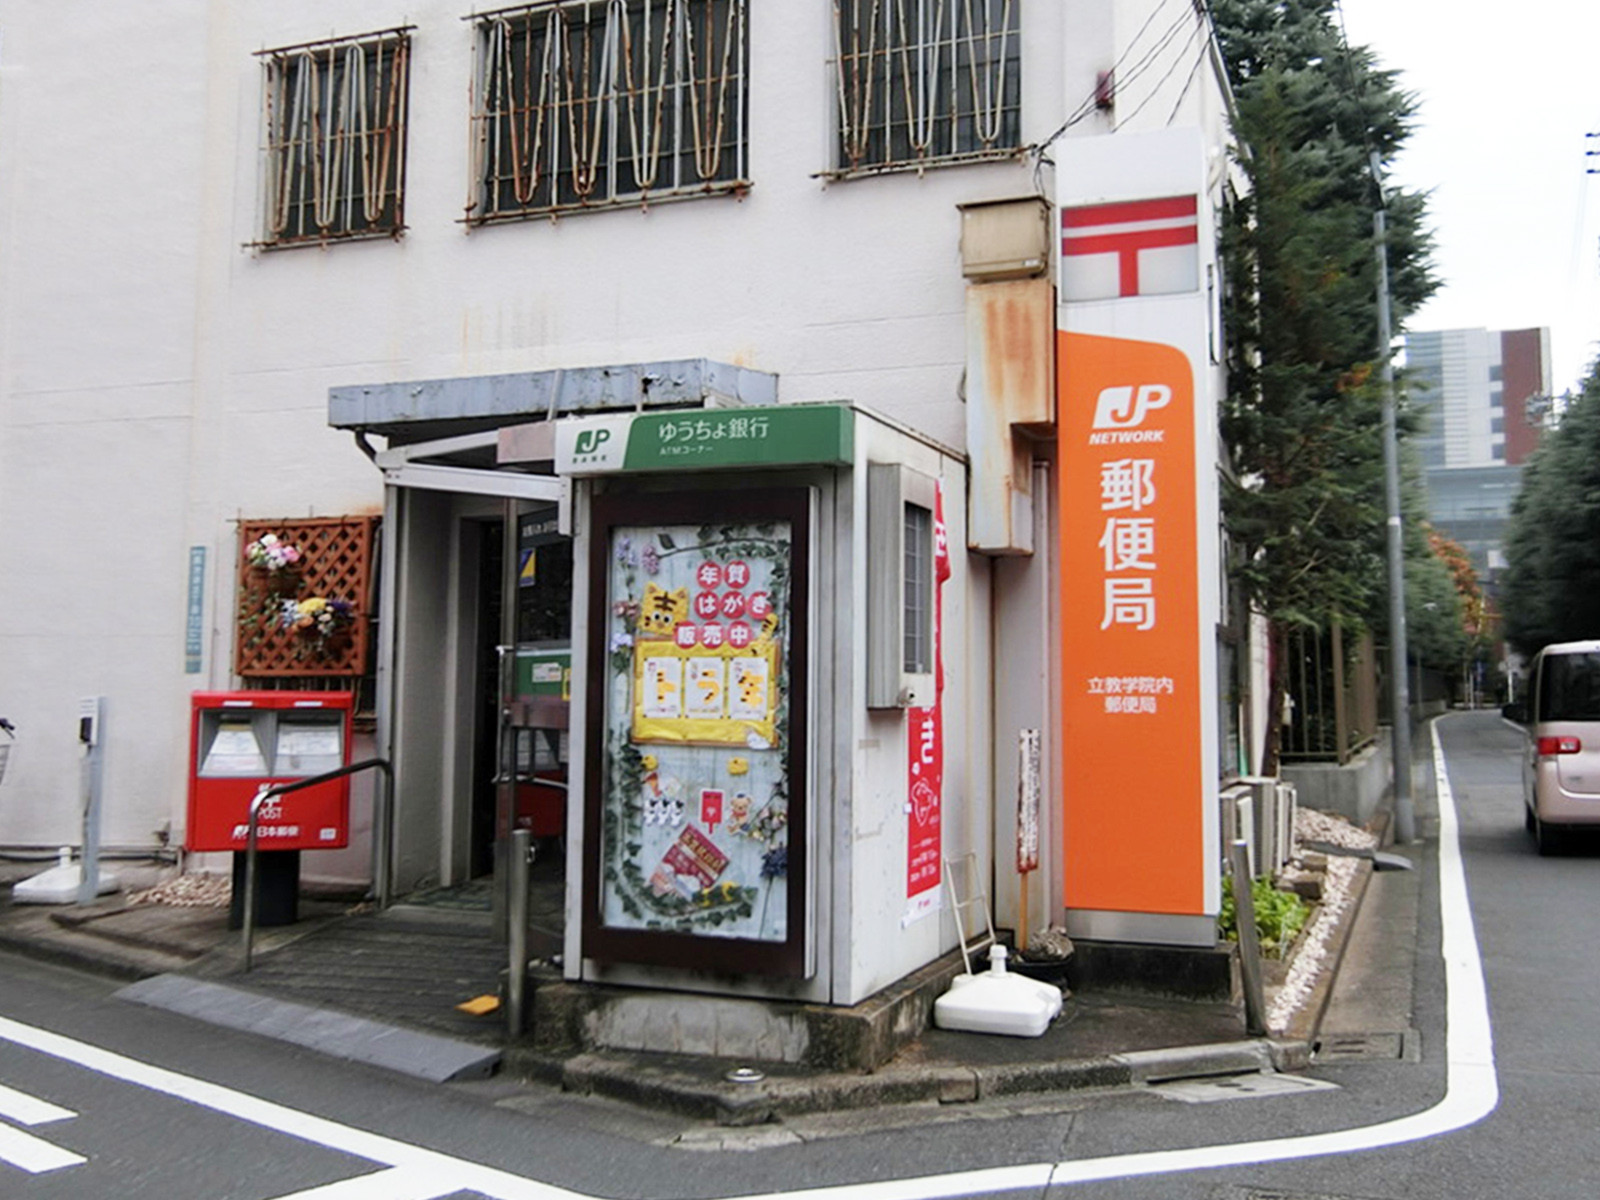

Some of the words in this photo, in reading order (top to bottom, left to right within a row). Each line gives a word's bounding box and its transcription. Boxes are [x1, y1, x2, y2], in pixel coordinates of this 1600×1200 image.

[1092, 384, 1172, 428] JP
[659, 416, 769, 442] ゆうちょ銀行
[1088, 429, 1165, 445] NETWORK
[575, 429, 611, 455] JP
[1098, 458, 1156, 631] 郵便局
[700, 564, 746, 586] 年賀
[699, 591, 770, 615] はがき
[676, 625, 749, 646] 販売中
[1087, 676, 1174, 694] 立教学院内
[1104, 695, 1157, 714] 郵便局
